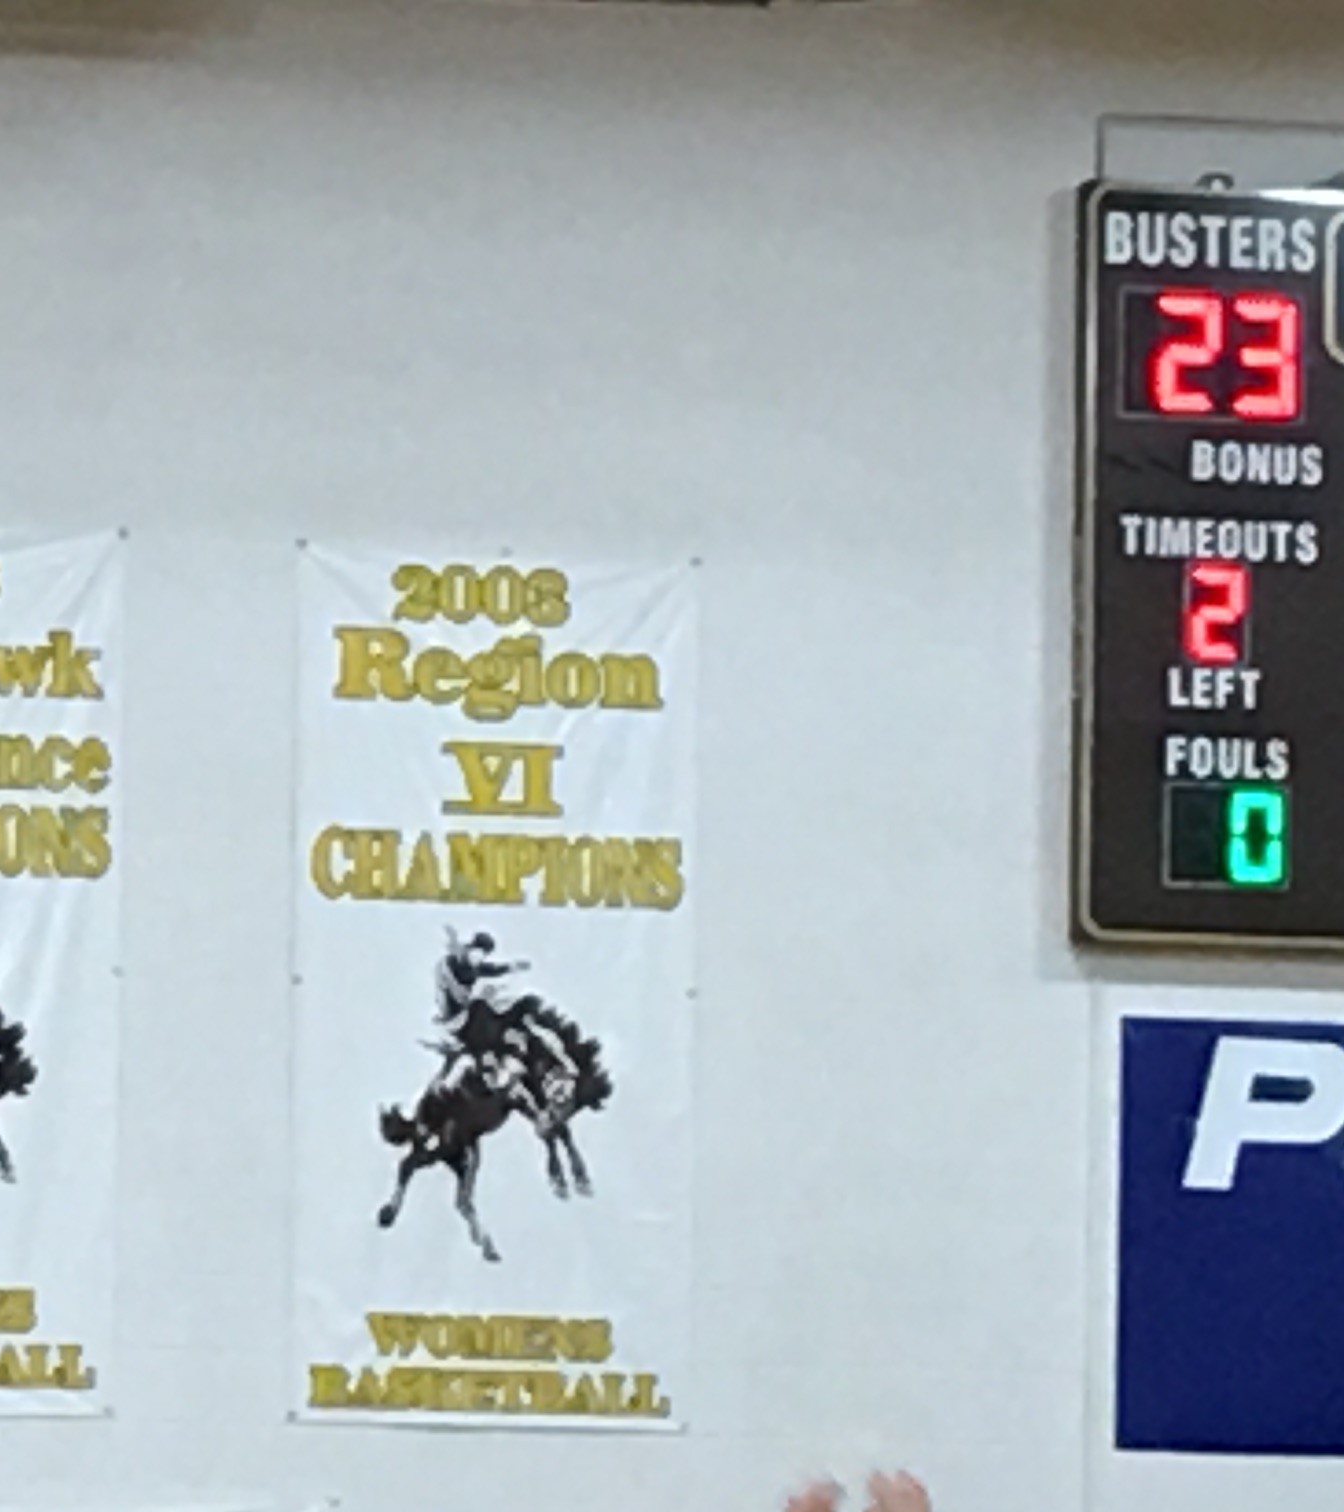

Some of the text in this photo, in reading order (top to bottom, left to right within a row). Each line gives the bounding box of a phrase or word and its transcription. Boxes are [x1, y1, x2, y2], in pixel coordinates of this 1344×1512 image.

[1105, 212, 1315, 271] BUSTERS
[1152, 288, 1301, 421] 23
[1190, 440, 1323, 485] BONUS
[1119, 514, 1319, 563] TIMEOUTS
[1185, 561, 1250, 664] 2
[333, 626, 664, 722] Region
[1167, 667, 1261, 709] LEFT
[441, 741, 564, 816] VI
[1165, 736, 1290, 779] FOULS
[1228, 790, 1284, 884] 0
[311, 823, 684, 911] CHAMPIONS
[365, 1311, 614, 1362] WOMENS
[307, 1363, 671, 1417] BASKETBALL
